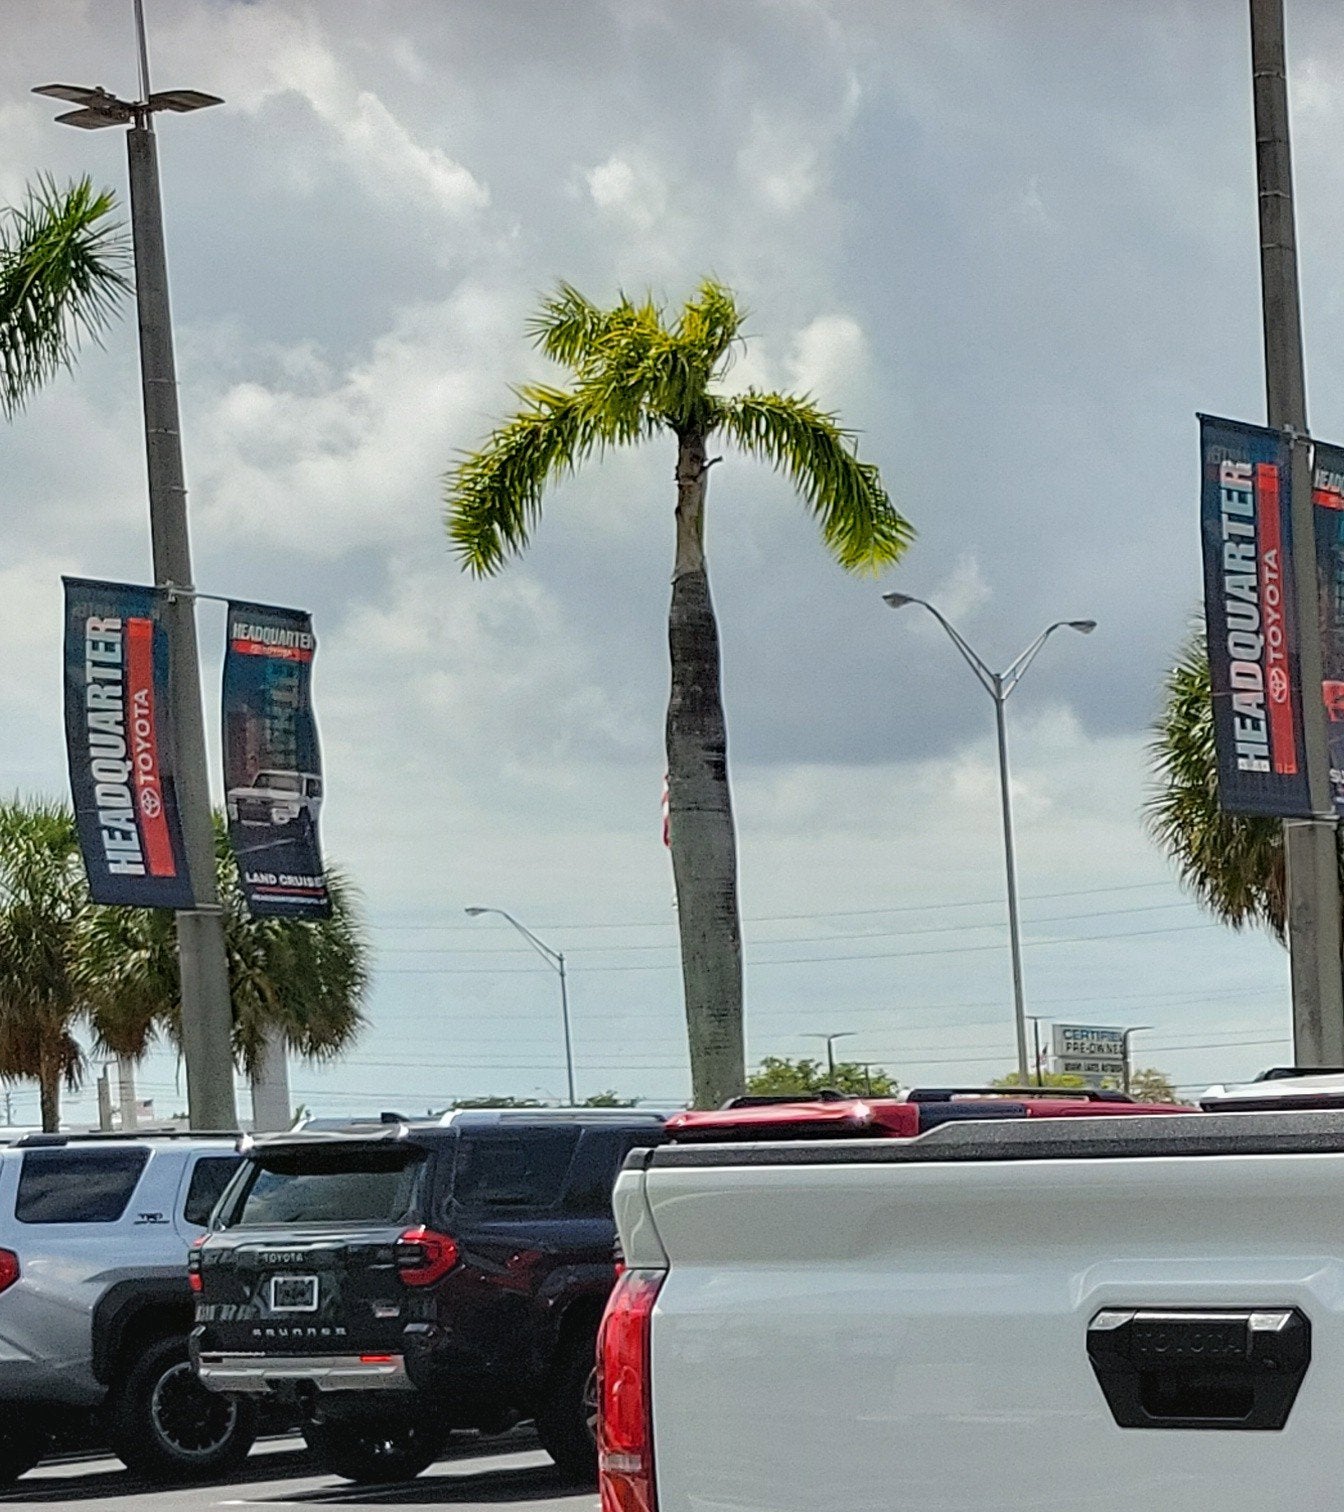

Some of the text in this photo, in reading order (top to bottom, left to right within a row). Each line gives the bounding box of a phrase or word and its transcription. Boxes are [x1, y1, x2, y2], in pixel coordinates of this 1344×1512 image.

[1220, 460, 1270, 772] HEADQUARTER
[1263, 549, 1282, 664] TOYOTA
[86, 616, 146, 876] HEADQUARTER
[133, 688, 155, 785] TOYOTA
[245, 871, 277, 885] LAND
[263, 1252, 305, 1263] TOYOTA
